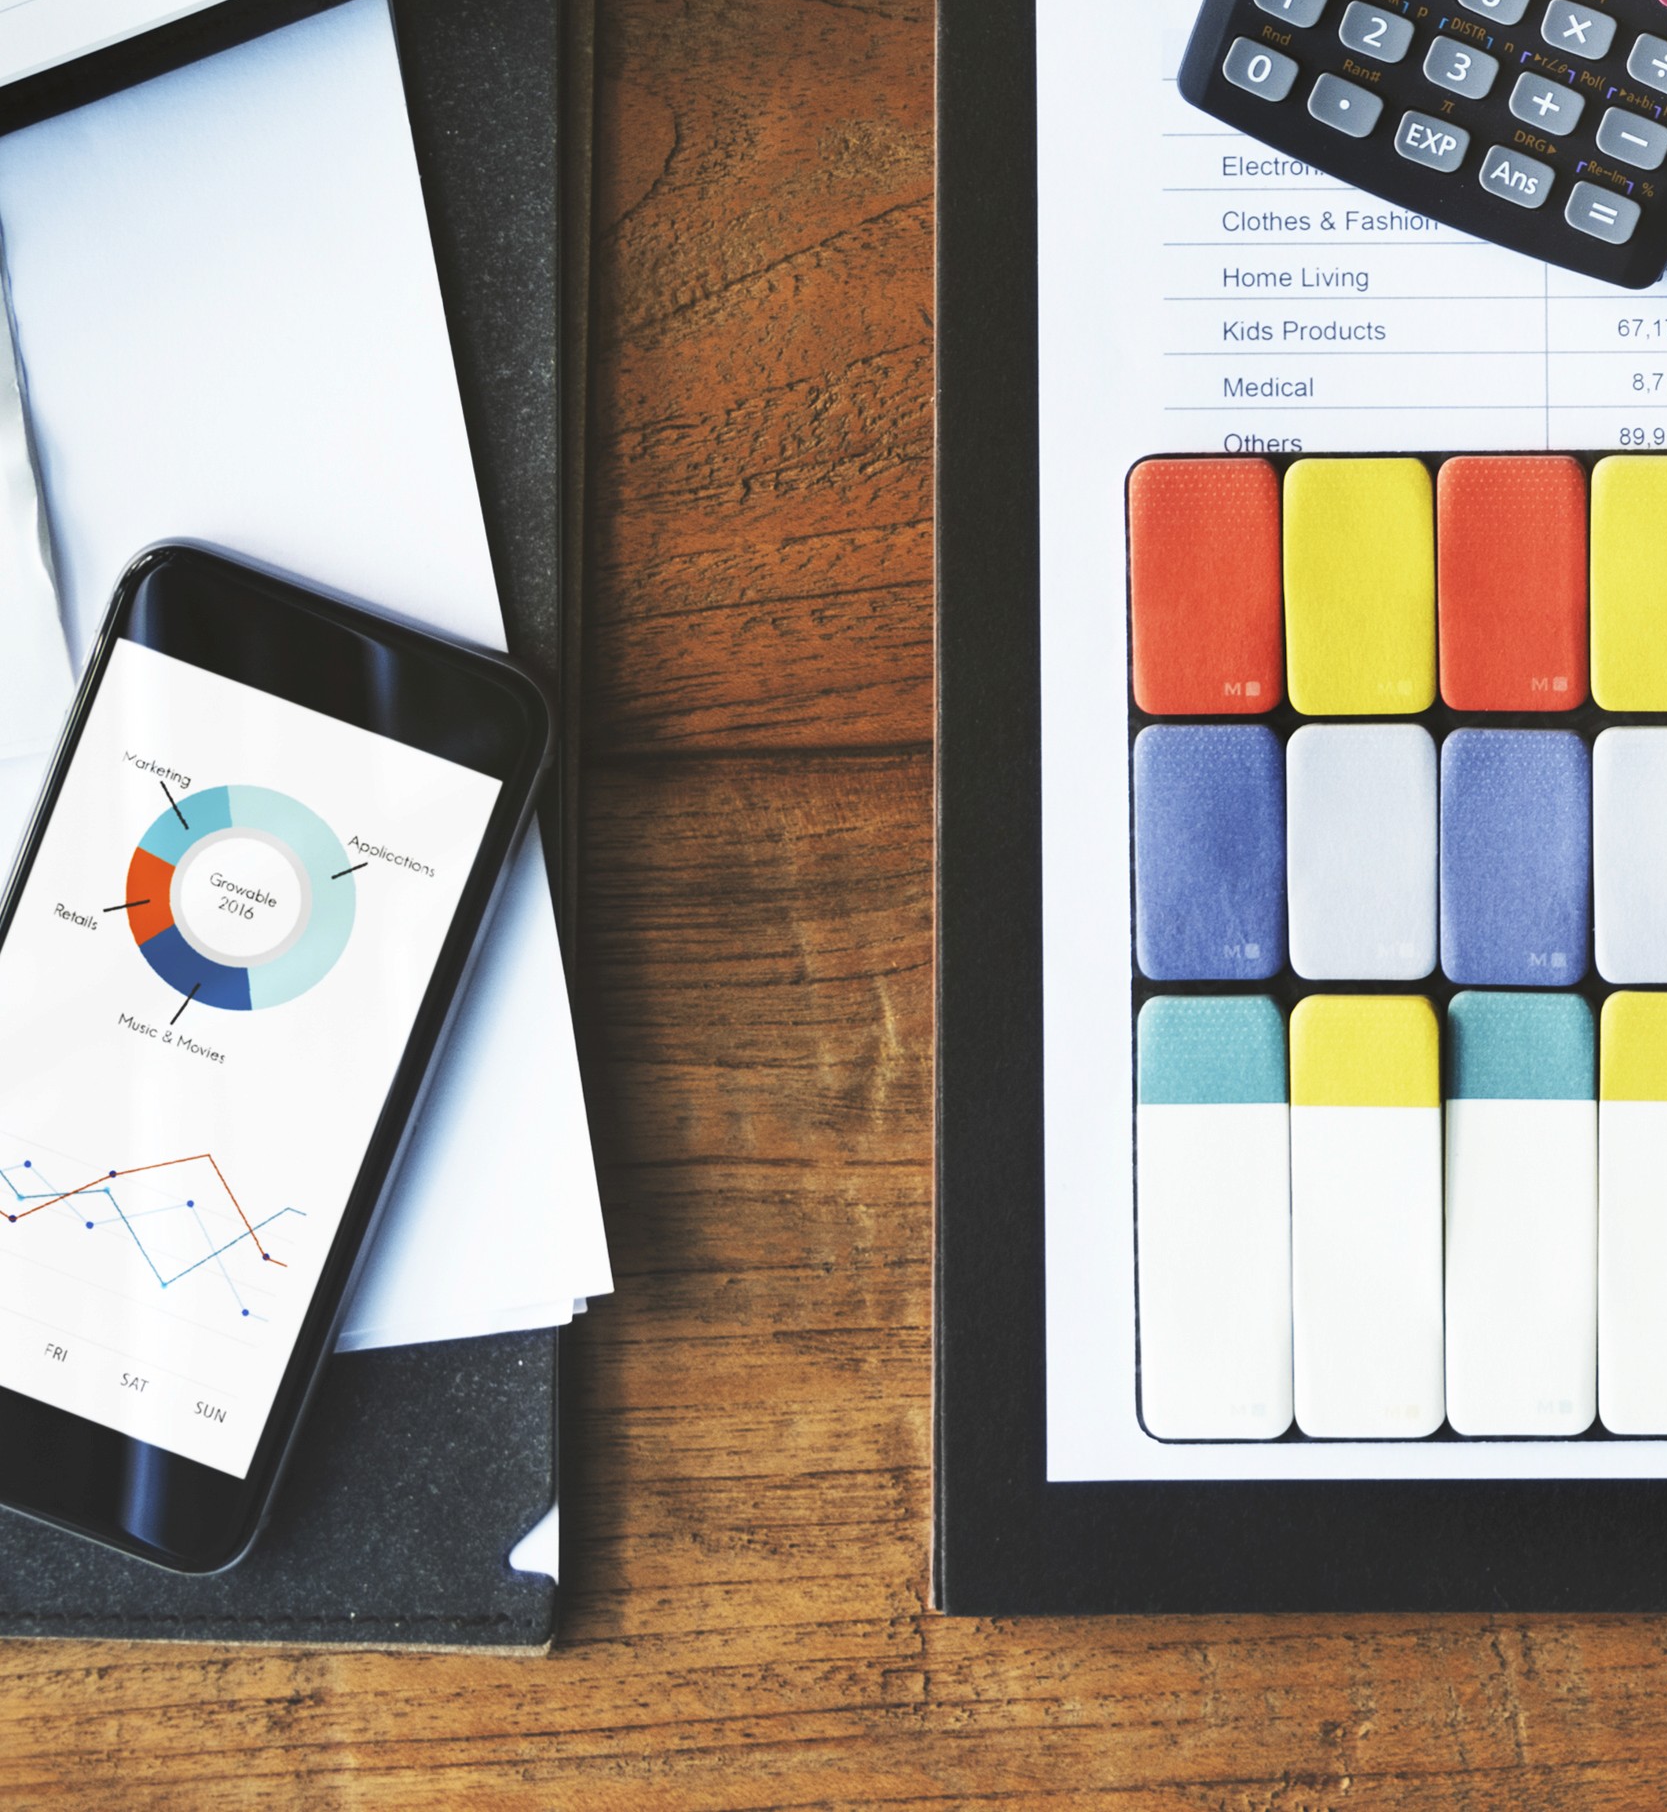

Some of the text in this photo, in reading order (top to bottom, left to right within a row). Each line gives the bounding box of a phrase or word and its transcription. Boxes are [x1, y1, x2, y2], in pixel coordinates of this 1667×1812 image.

[1363, 17, 1388, 47] 2
[1247, 54, 1272, 83] 0
[1446, 53, 1472, 82] 3
[1405, 123, 1457, 156] EXP
[1490, 161, 1539, 195] Ans
[1222, 211, 1311, 232] Clothes
[1320, 211, 1336, 232] &
[1223, 268, 1293, 288] Home
[1302, 267, 1369, 293] Living
[1224, 321, 1273, 341] Kids
[1283, 321, 1386, 341] Products
[1224, 377, 1314, 397] Medical
[1224, 434, 1303, 452] Others
[122, 750, 191, 790] Marketing
[348, 835, 435, 878] Applications
[209, 872, 278, 908] Growable
[54, 903, 98, 931] Retails
[218, 896, 254, 920] 2016
[118, 1013, 227, 1064] Music & Movies
[44, 1343, 68, 1362] FRI
[120, 1372, 150, 1393] SAT
[194, 1401, 227, 1423] SUN
